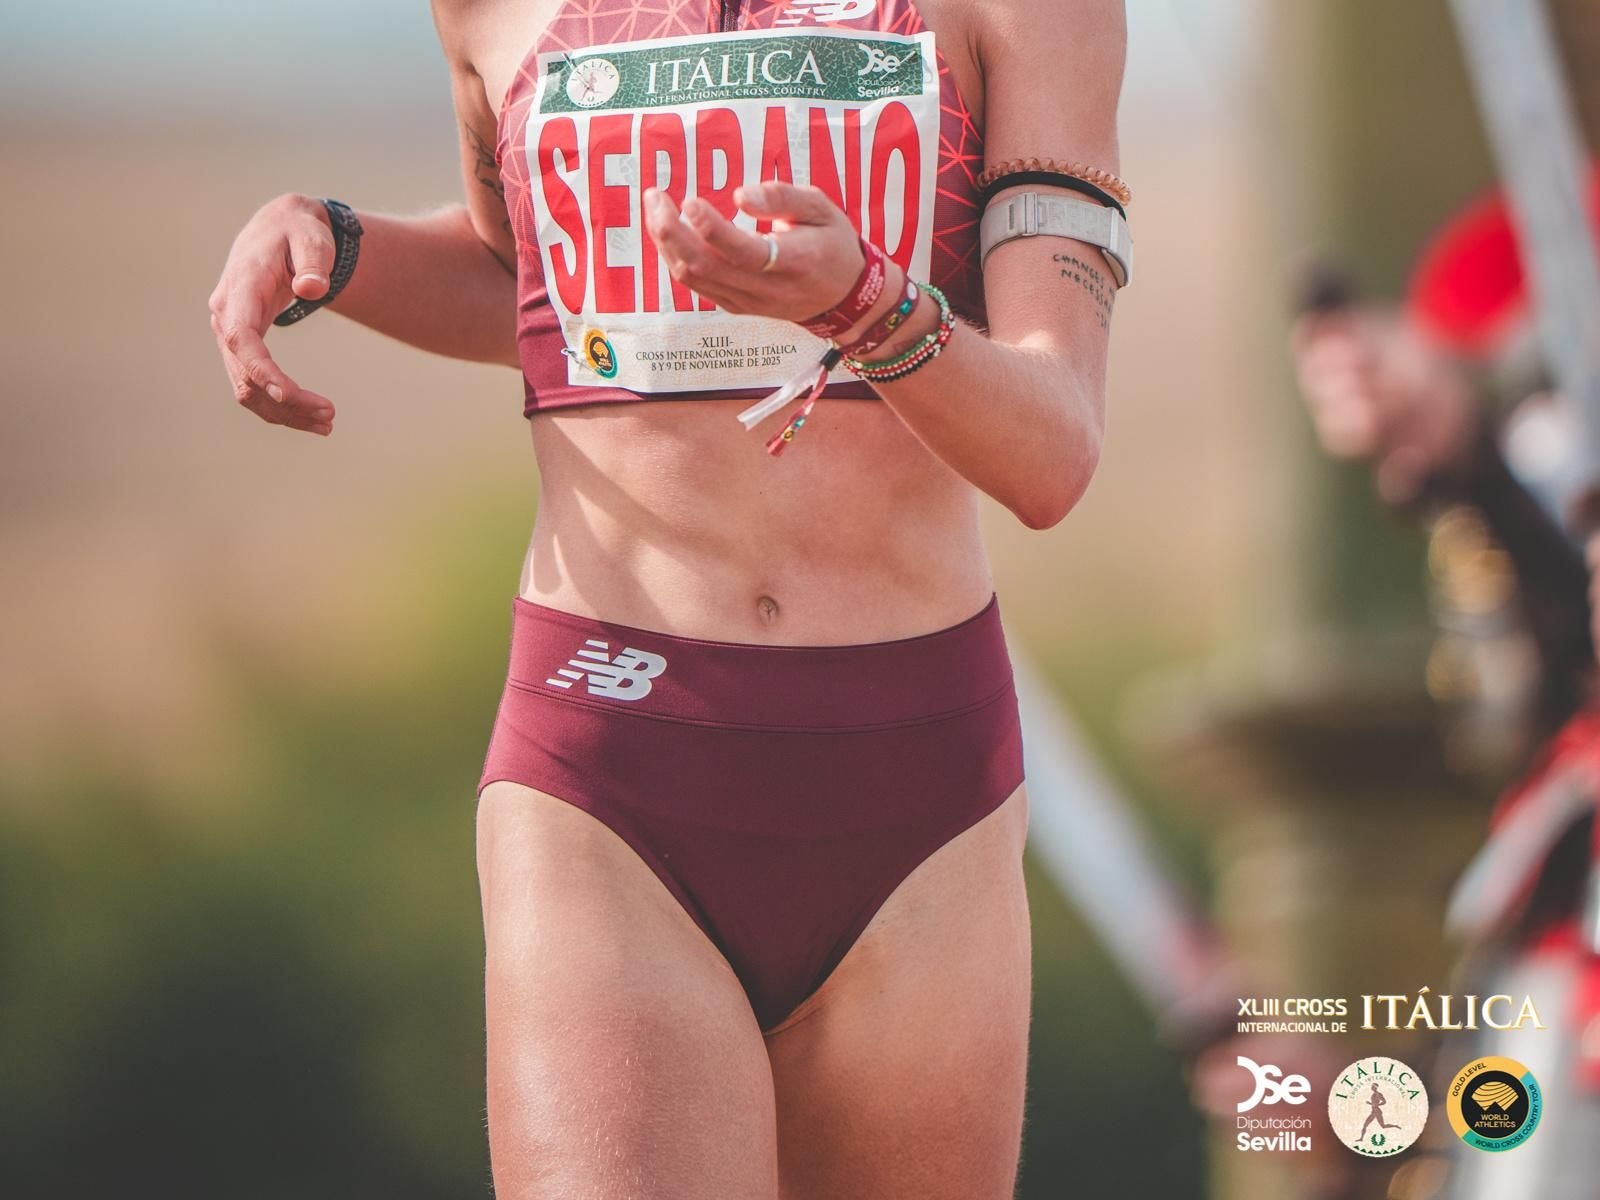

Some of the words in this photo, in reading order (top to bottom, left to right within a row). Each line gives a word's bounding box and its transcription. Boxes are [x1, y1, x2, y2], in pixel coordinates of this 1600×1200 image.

[645, 47, 827, 95] ITÁLICA
[646, 88, 730, 105] INTERNATIONAL
[736, 86, 769, 97] CROSS
[774, 86, 826, 97] COUNTRY
[857, 85, 899, 98] Sevilla
[635, 351, 664, 361] CROSS
[667, 348, 744, 360] INTERNACIONAL
[747, 347, 759, 356] DE
[651, 362, 657, 371] 8
[659, 362, 664, 371] Y
[666, 361, 672, 370] 9
[674, 361, 687, 371] DE
[689, 358, 744, 370] NOVIEMBRE
[747, 357, 759, 367] DE
[761, 356, 781, 366] 2025
